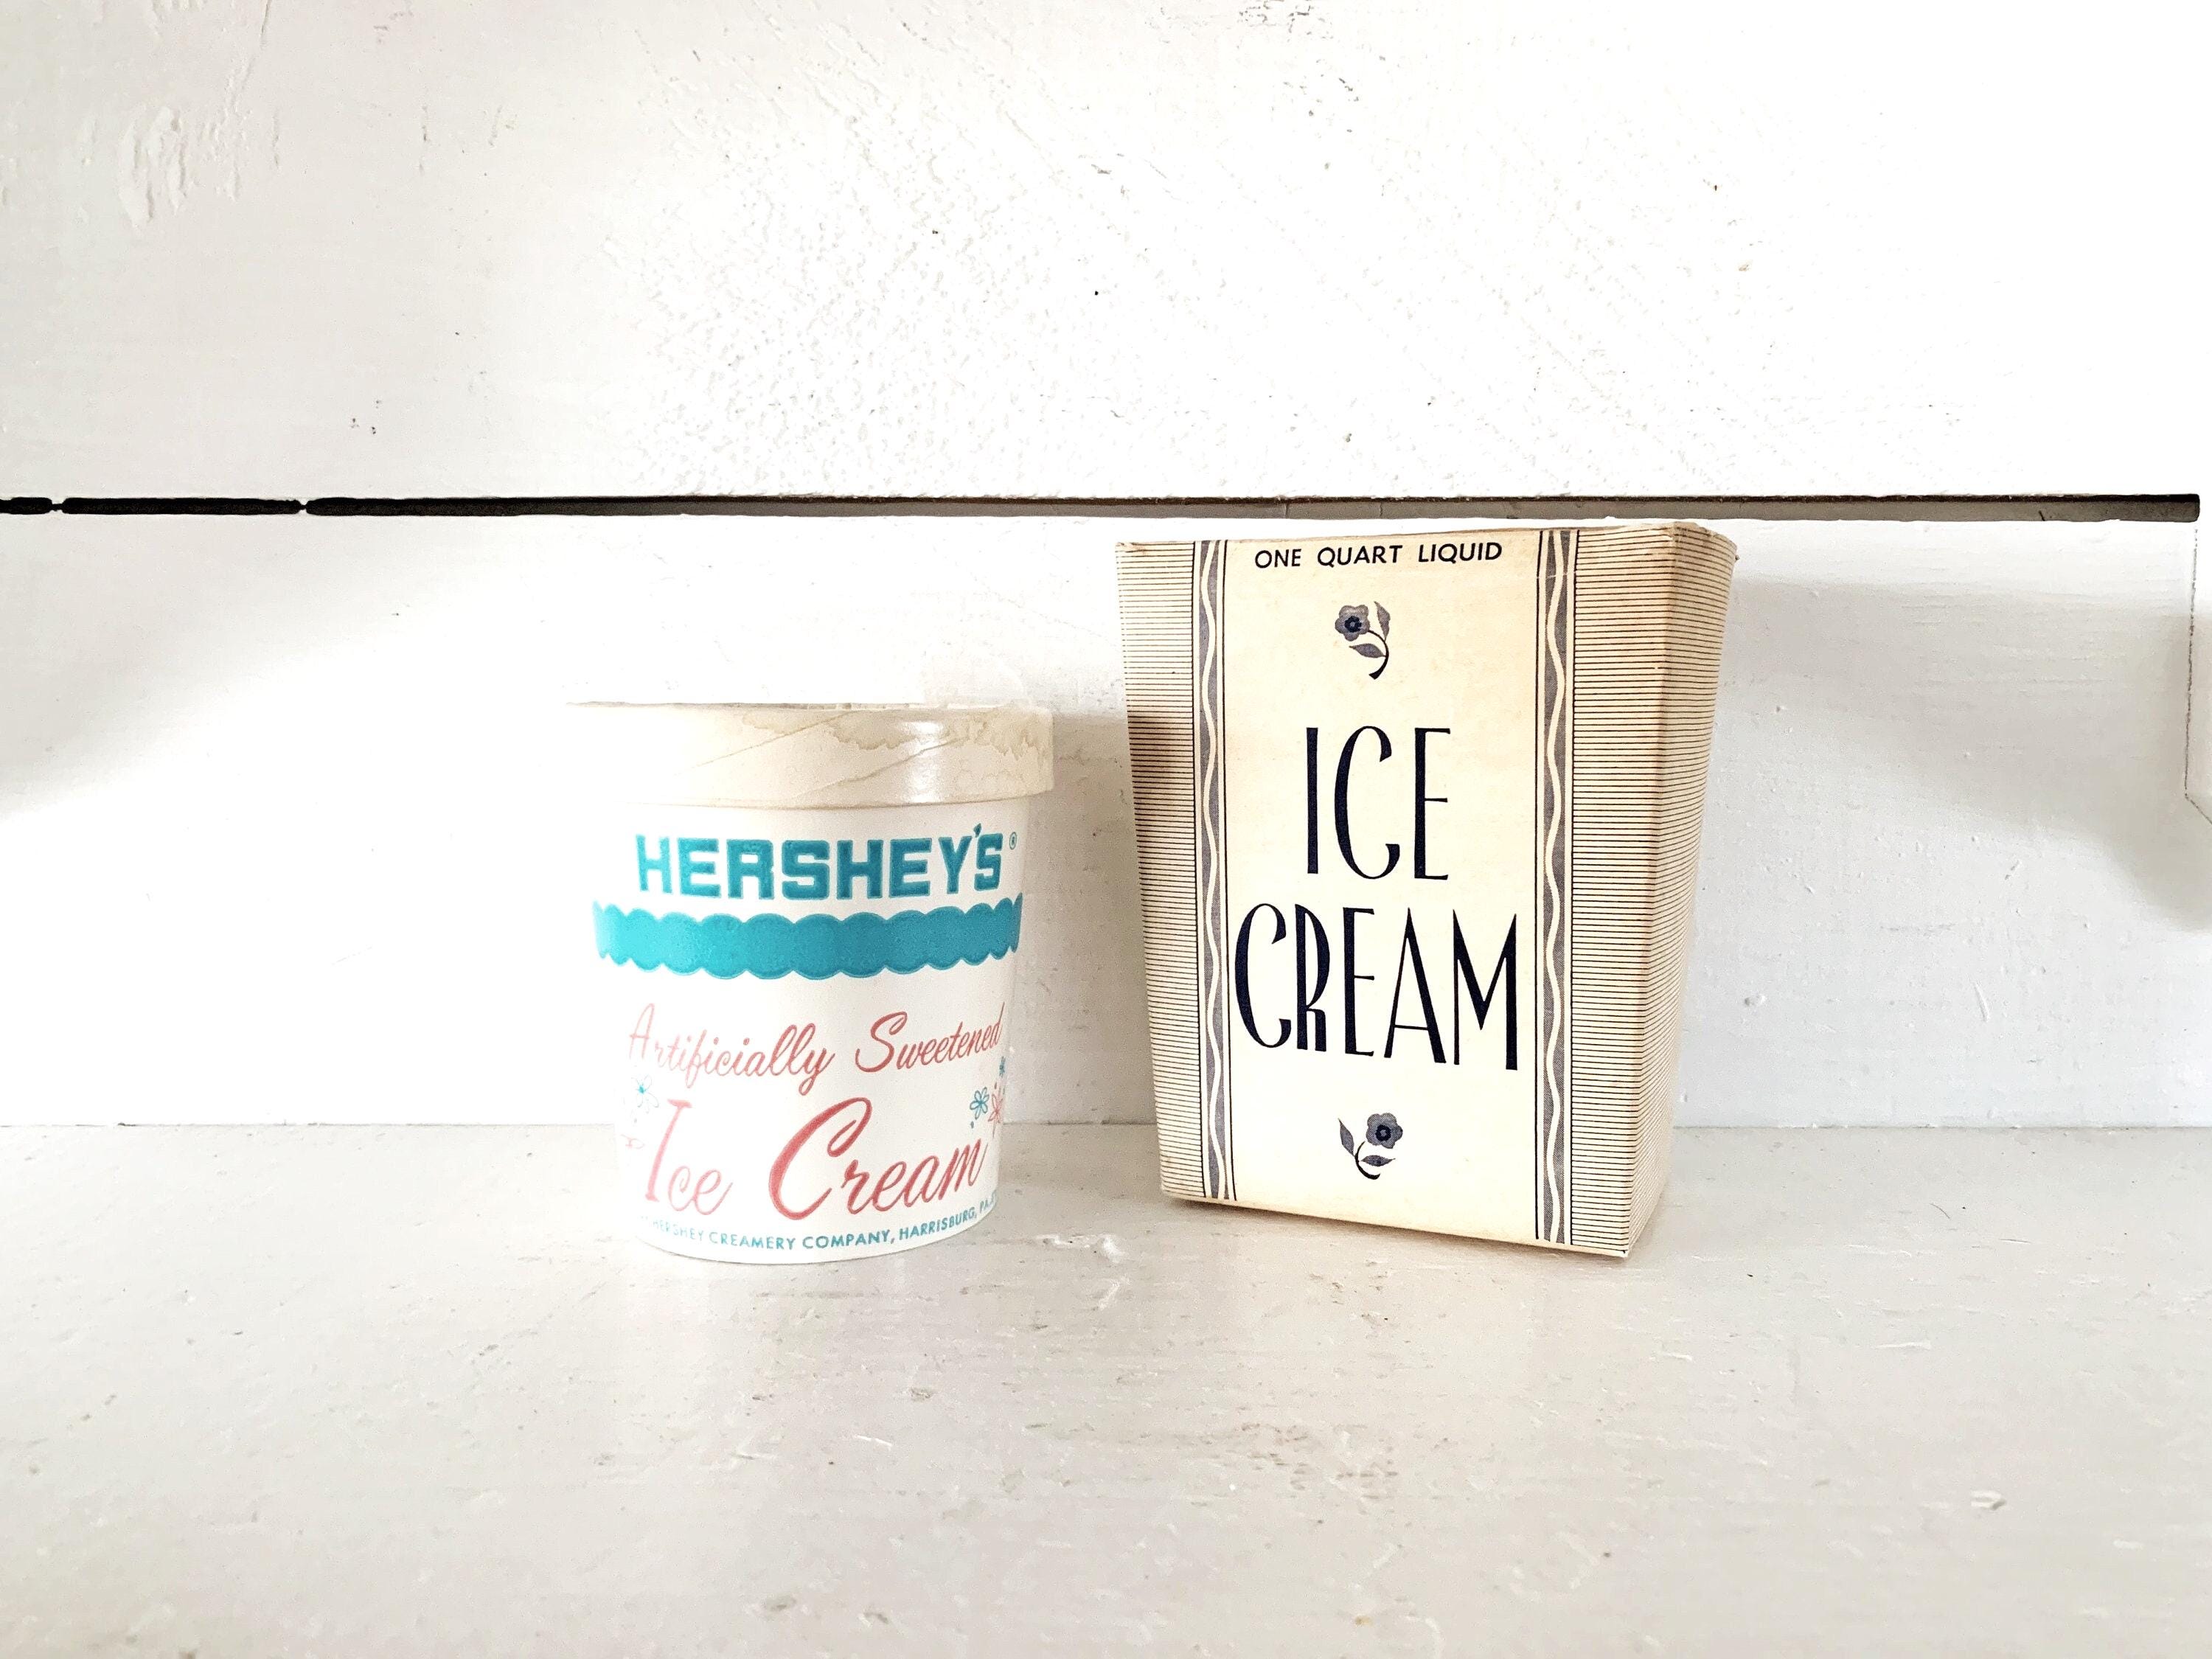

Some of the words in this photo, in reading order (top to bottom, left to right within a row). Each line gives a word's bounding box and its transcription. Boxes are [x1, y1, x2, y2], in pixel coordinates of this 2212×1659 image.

[1254, 548, 1302, 568] ONE
[1316, 545, 1403, 568] QUART
[1417, 541, 1503, 564] LIQUID
[1305, 725, 1452, 880] ICE
[635, 822, 1004, 901] HERSHEY'S
[1234, 902, 1518, 1071] CREAM
[628, 1002, 836, 1096] Artificially
[854, 1001, 1006, 1074] Sweetened
[644, 1098, 734, 1216] Ice
[768, 1096, 988, 1221] Cream
[653, 1219, 704, 1242] HERSHEY
[709, 1231, 796, 1251] CREAMERY
[801, 1228, 895, 1250] COMPANY,
[898, 1206, 978, 1241] HARRISBURG,
